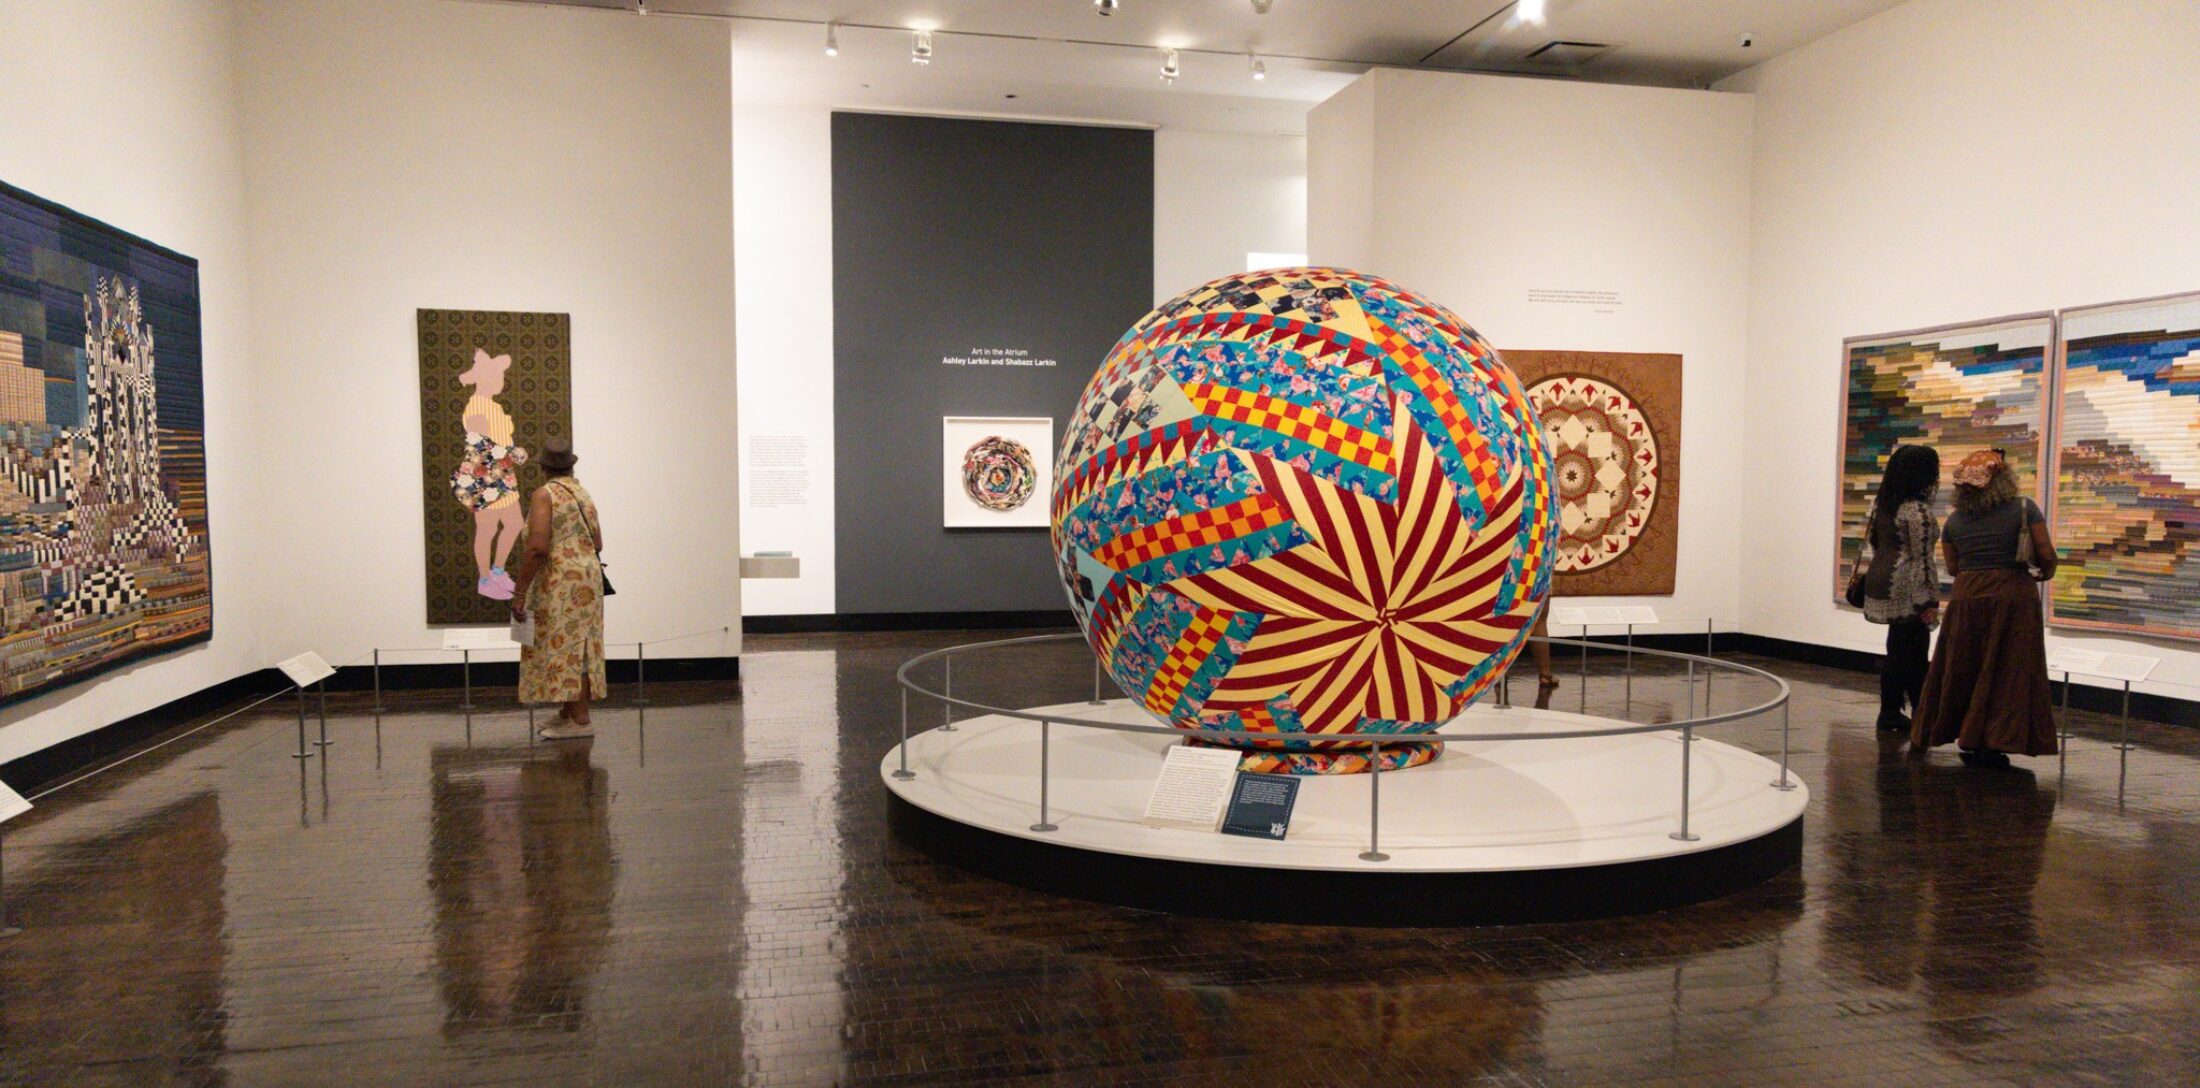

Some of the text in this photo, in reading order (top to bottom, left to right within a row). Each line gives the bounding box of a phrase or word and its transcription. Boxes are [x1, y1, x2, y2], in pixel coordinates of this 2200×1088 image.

[971, 347, 1028, 357] Art in the Atrium
[942, 356, 1057, 367] Ashley Larkin and Shabazz Larkin
